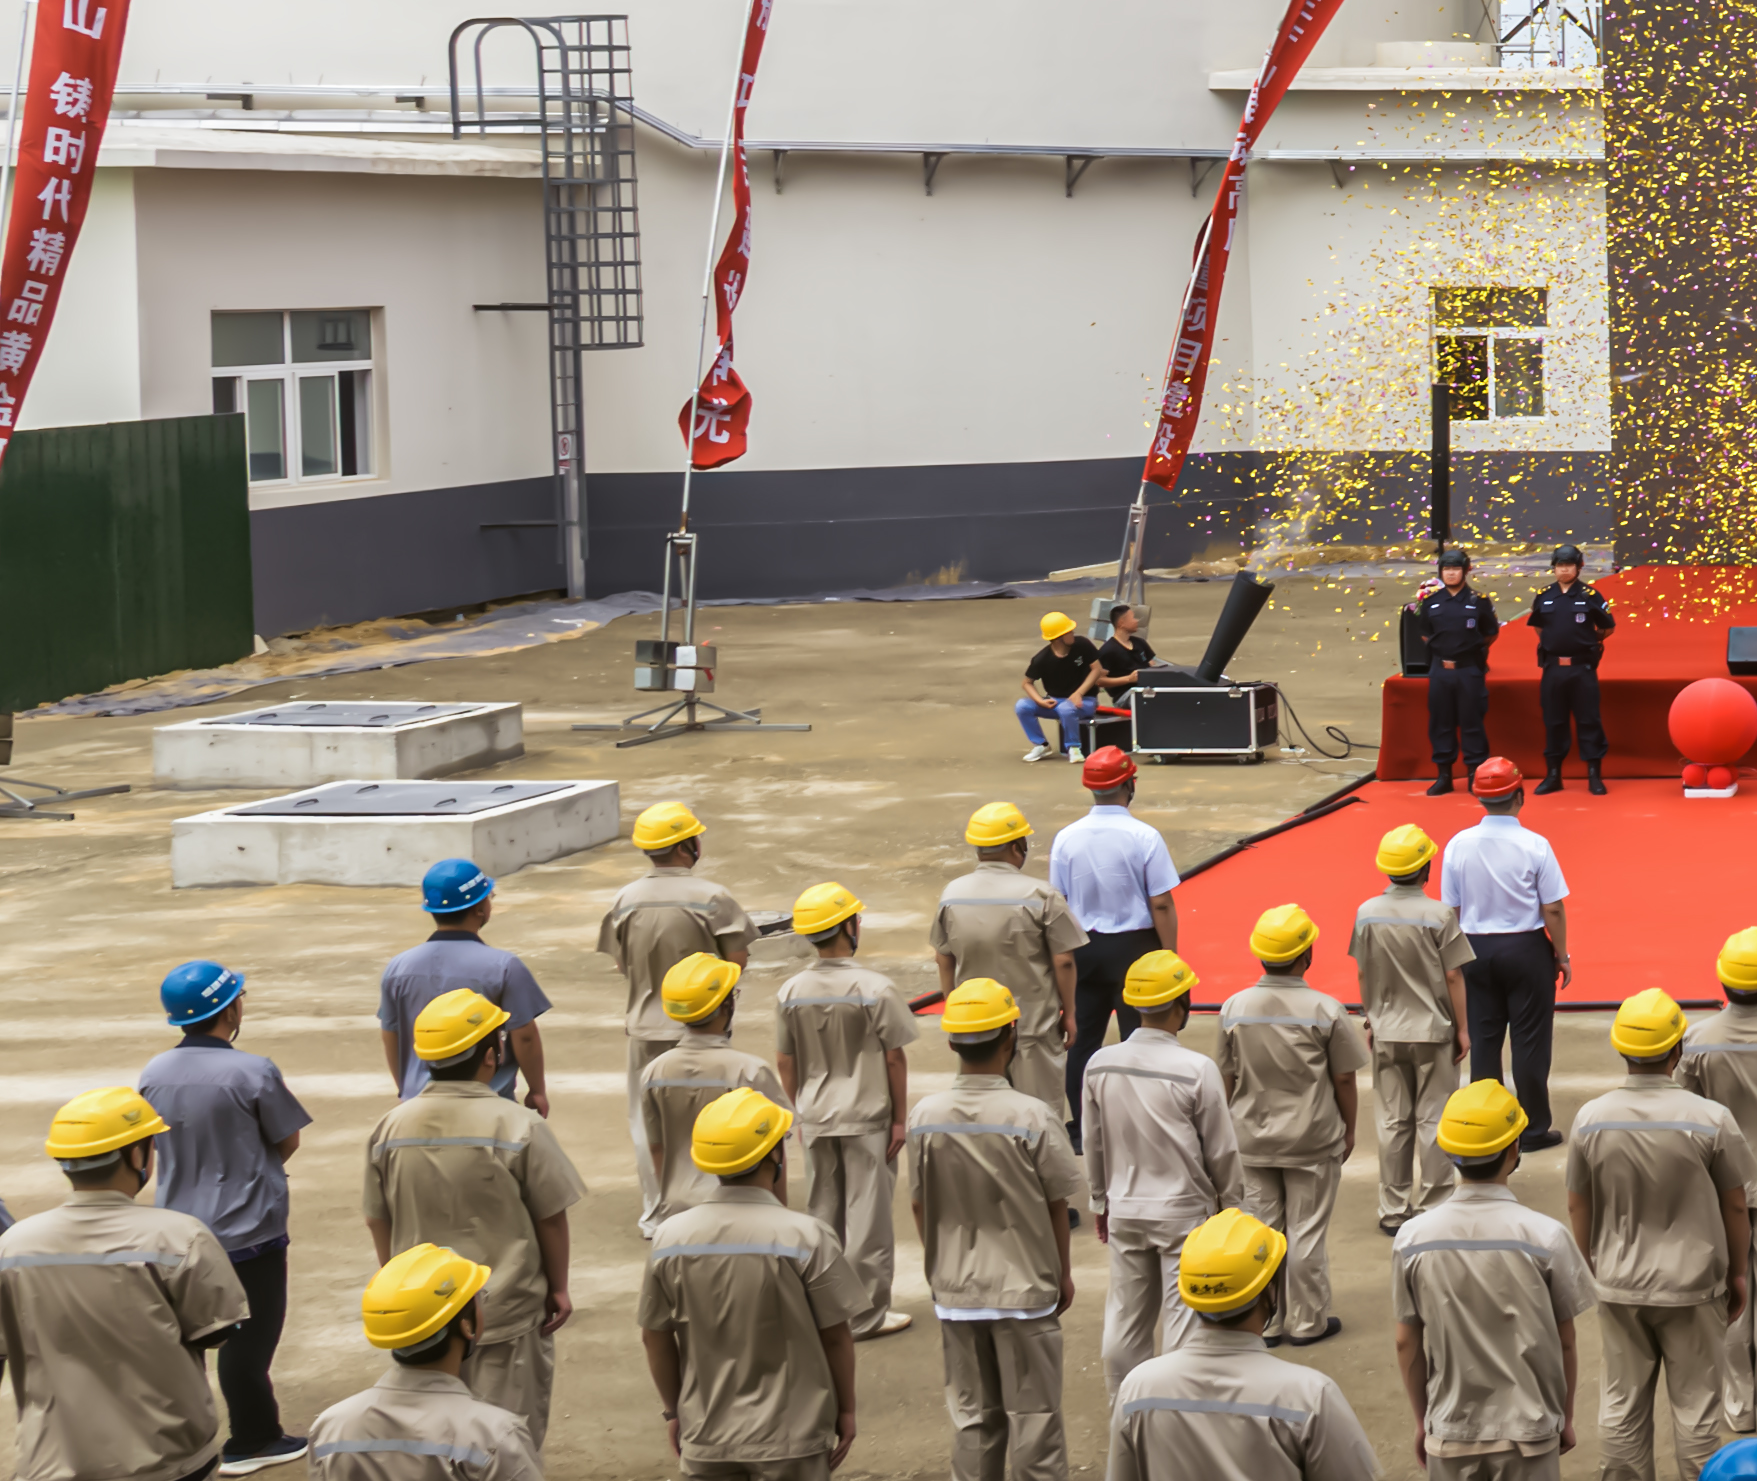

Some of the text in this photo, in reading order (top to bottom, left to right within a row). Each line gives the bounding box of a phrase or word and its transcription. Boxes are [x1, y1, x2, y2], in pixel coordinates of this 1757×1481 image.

[0, 71, 94, 463] 铸时代精品黄金
